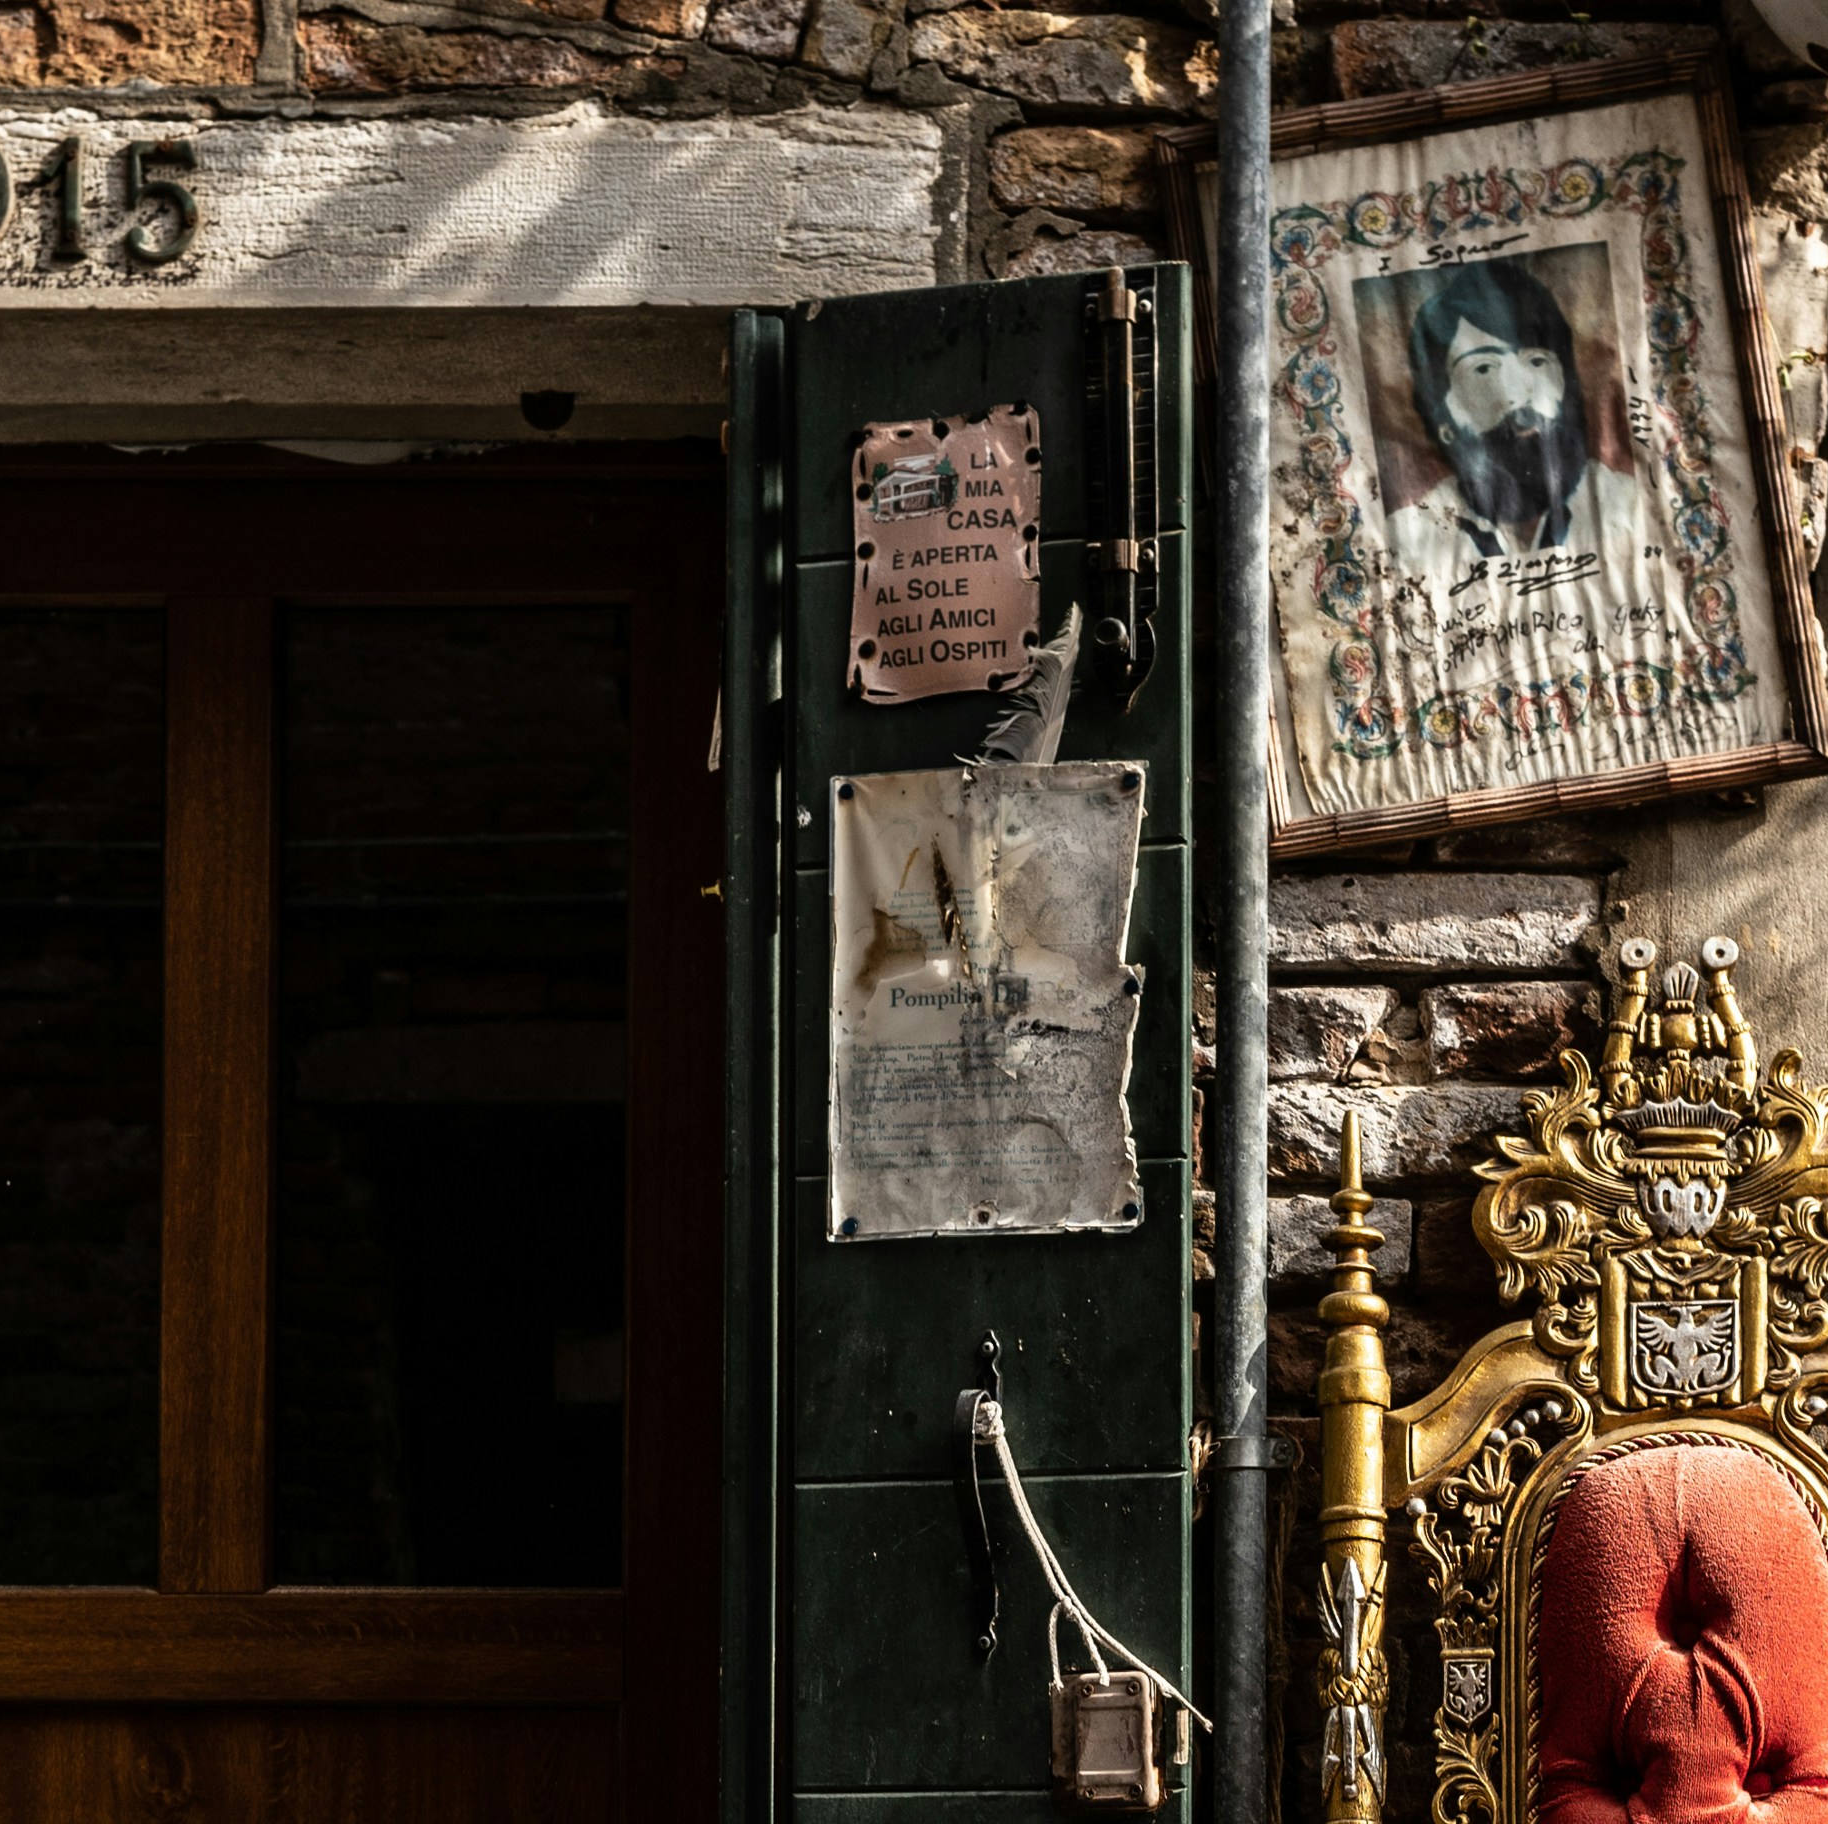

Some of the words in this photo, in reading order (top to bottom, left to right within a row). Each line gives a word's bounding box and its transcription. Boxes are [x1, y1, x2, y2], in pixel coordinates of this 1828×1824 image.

[971, 453, 999, 470] LA
[965, 480, 1004, 498] MIA
[947, 508, 1018, 531] CASA
[892, 549, 905, 571] È
[911, 544, 999, 568] APERTA
[875, 586, 901, 606] AL
[877, 614, 923, 638] AGLI
[879, 646, 924, 669] AGLI
[890, 981, 983, 1011] Pompilio
